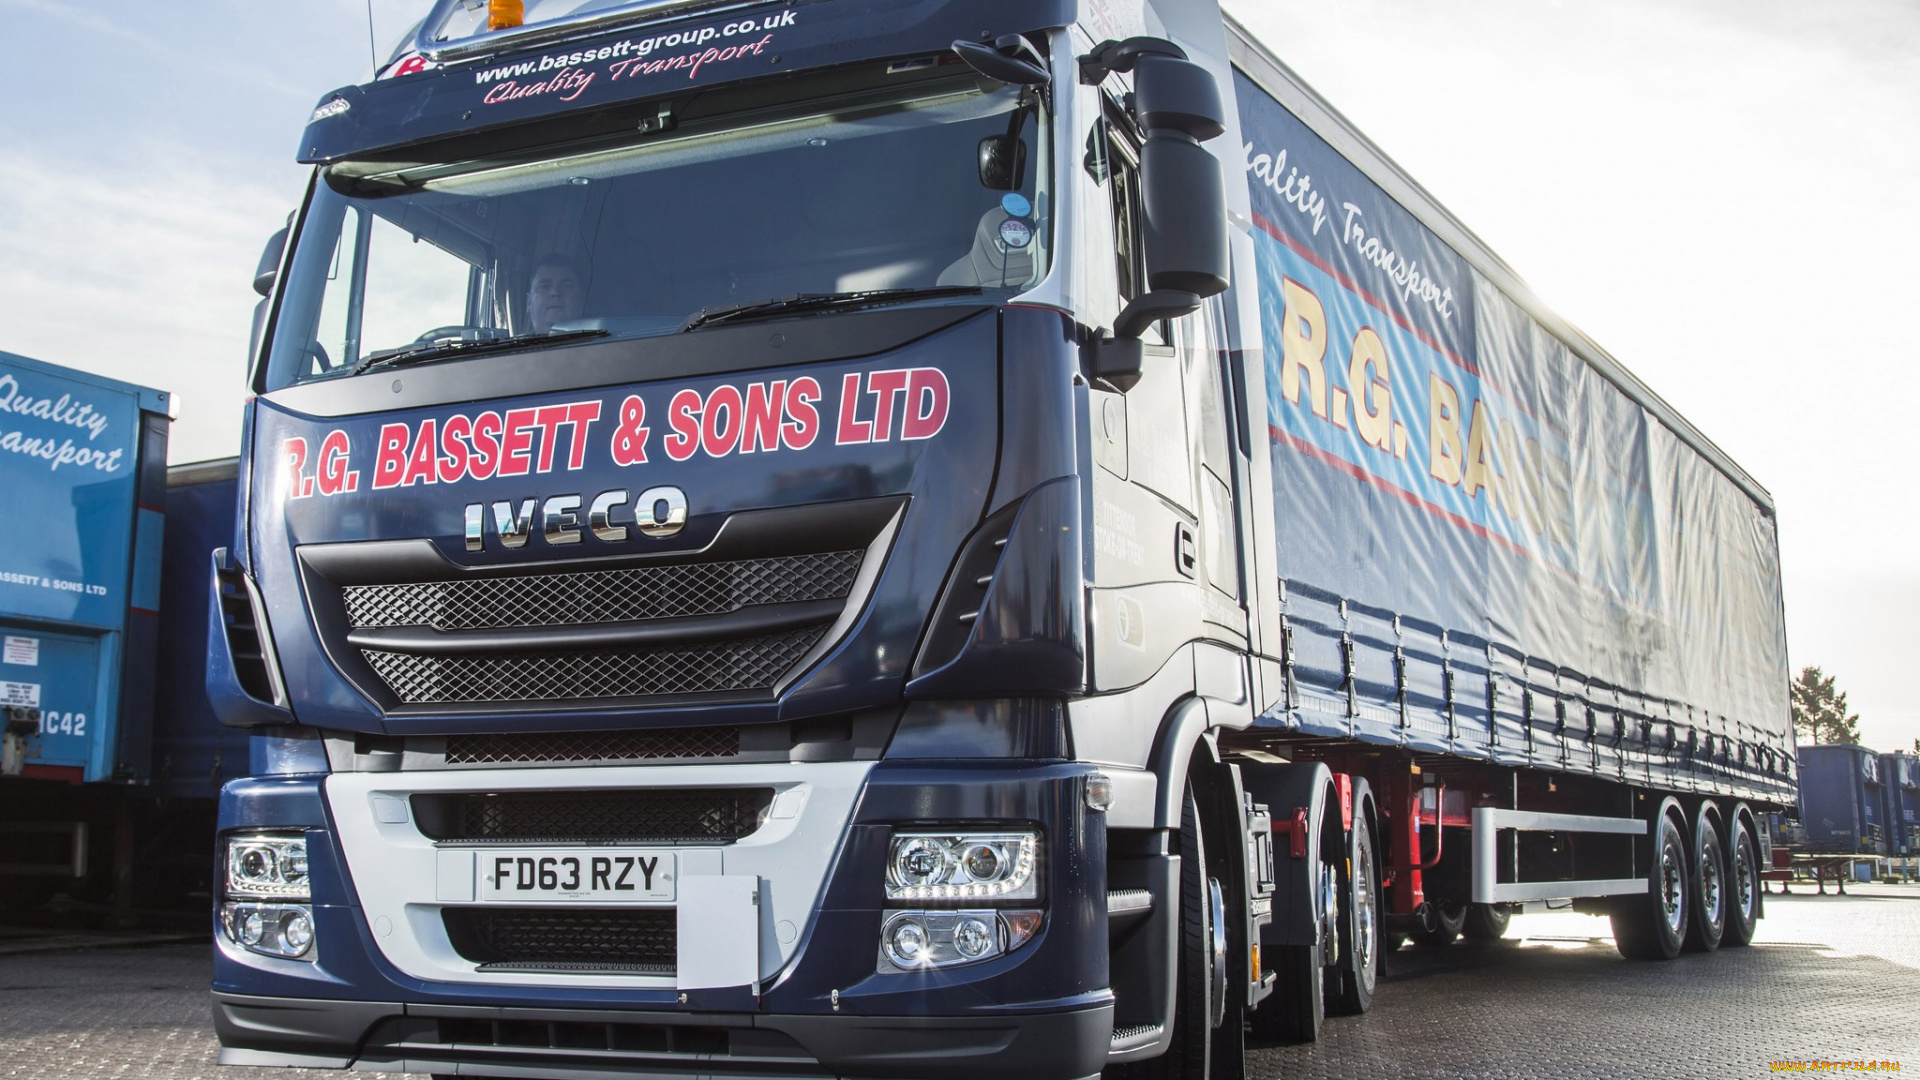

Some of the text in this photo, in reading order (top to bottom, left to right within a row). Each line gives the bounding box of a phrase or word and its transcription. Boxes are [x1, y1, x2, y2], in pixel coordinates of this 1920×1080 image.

[475, 10, 796, 84] www.bassett-group.co.uk
[483, 33, 775, 104] Quality Transport
[1343, 202, 1453, 320] Transport
[1282, 274, 1408, 461] R.G.
[0, 373, 108, 441] Quality
[283, 366, 951, 500] R.G. BASSETT & SONS LTD
[0, 430, 123, 473] ansport
[464, 485, 689, 554] IVECO
[41, 577, 50, 588] &
[53, 579, 84, 593] SONS
[85, 584, 107, 596] LTD
[39, 711, 86, 736] C42
[494, 856, 658, 891] FD63 RZY
